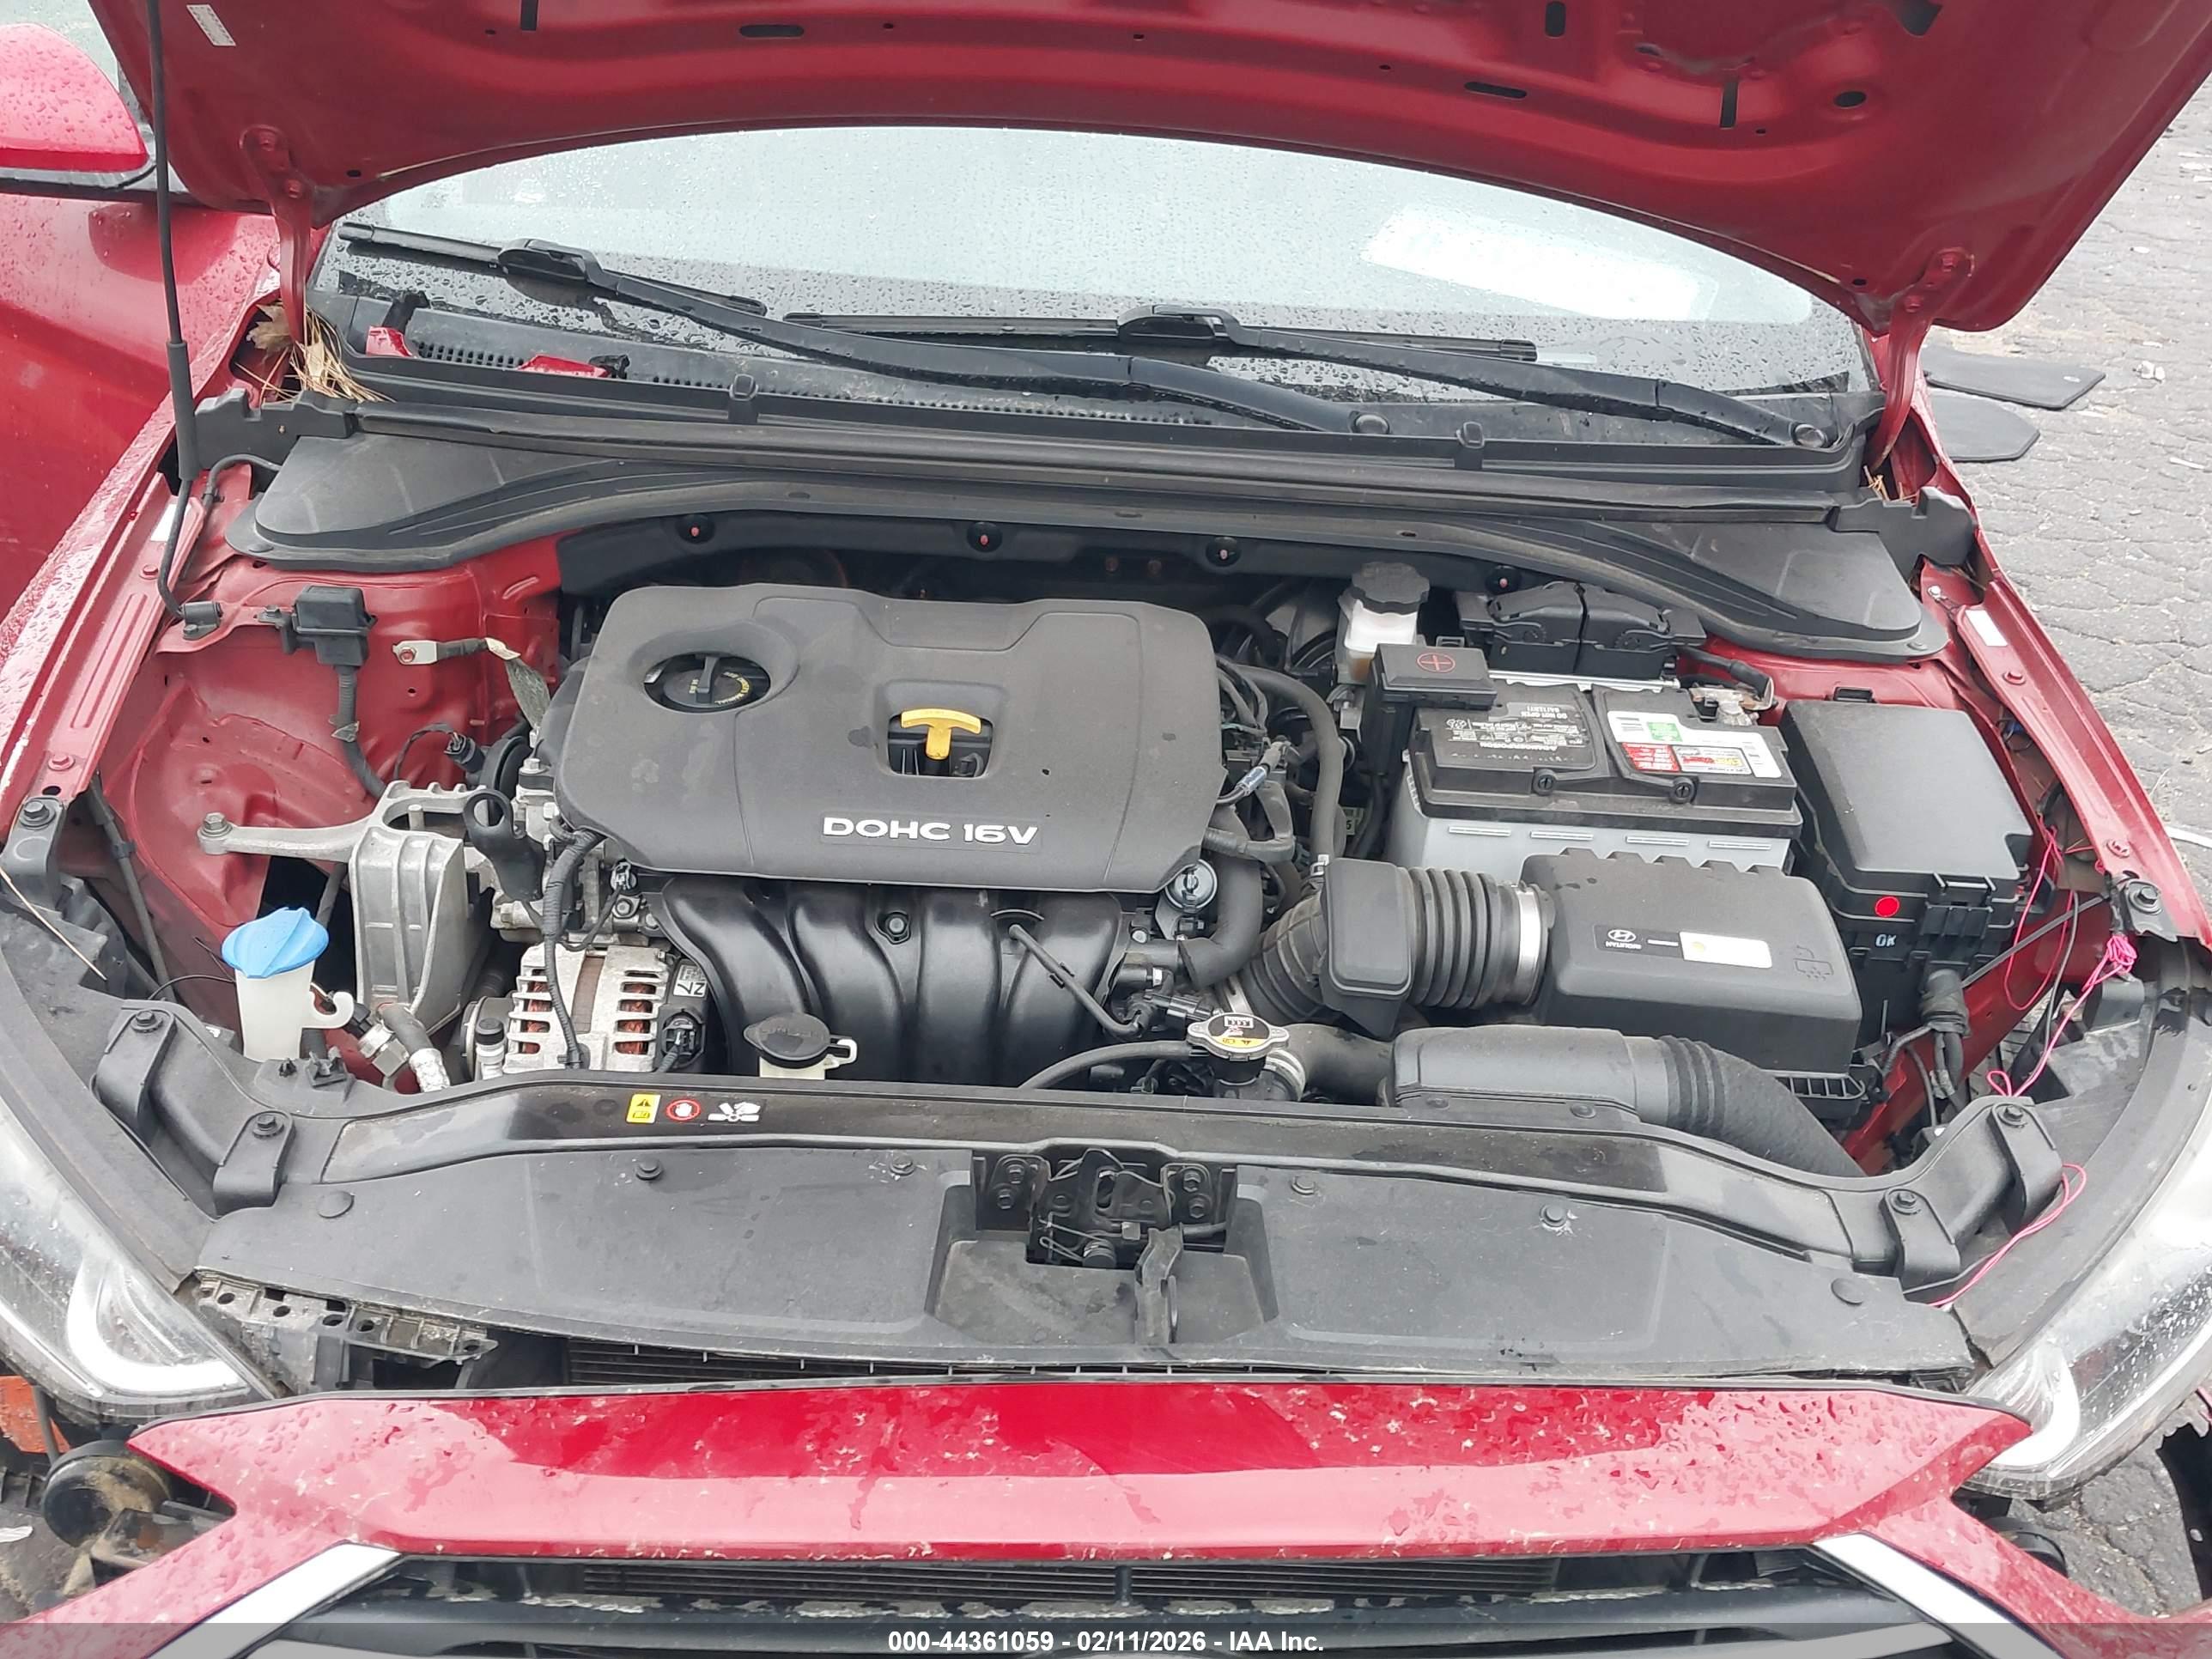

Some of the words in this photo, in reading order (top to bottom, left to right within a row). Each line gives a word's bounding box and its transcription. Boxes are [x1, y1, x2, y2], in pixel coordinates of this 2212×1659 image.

[822, 817, 952, 842] DOHC
[963, 823, 1039, 845] 16V
[1605, 940, 1642, 950] HYUNDAI
[1875, 933, 1897, 947] OK
